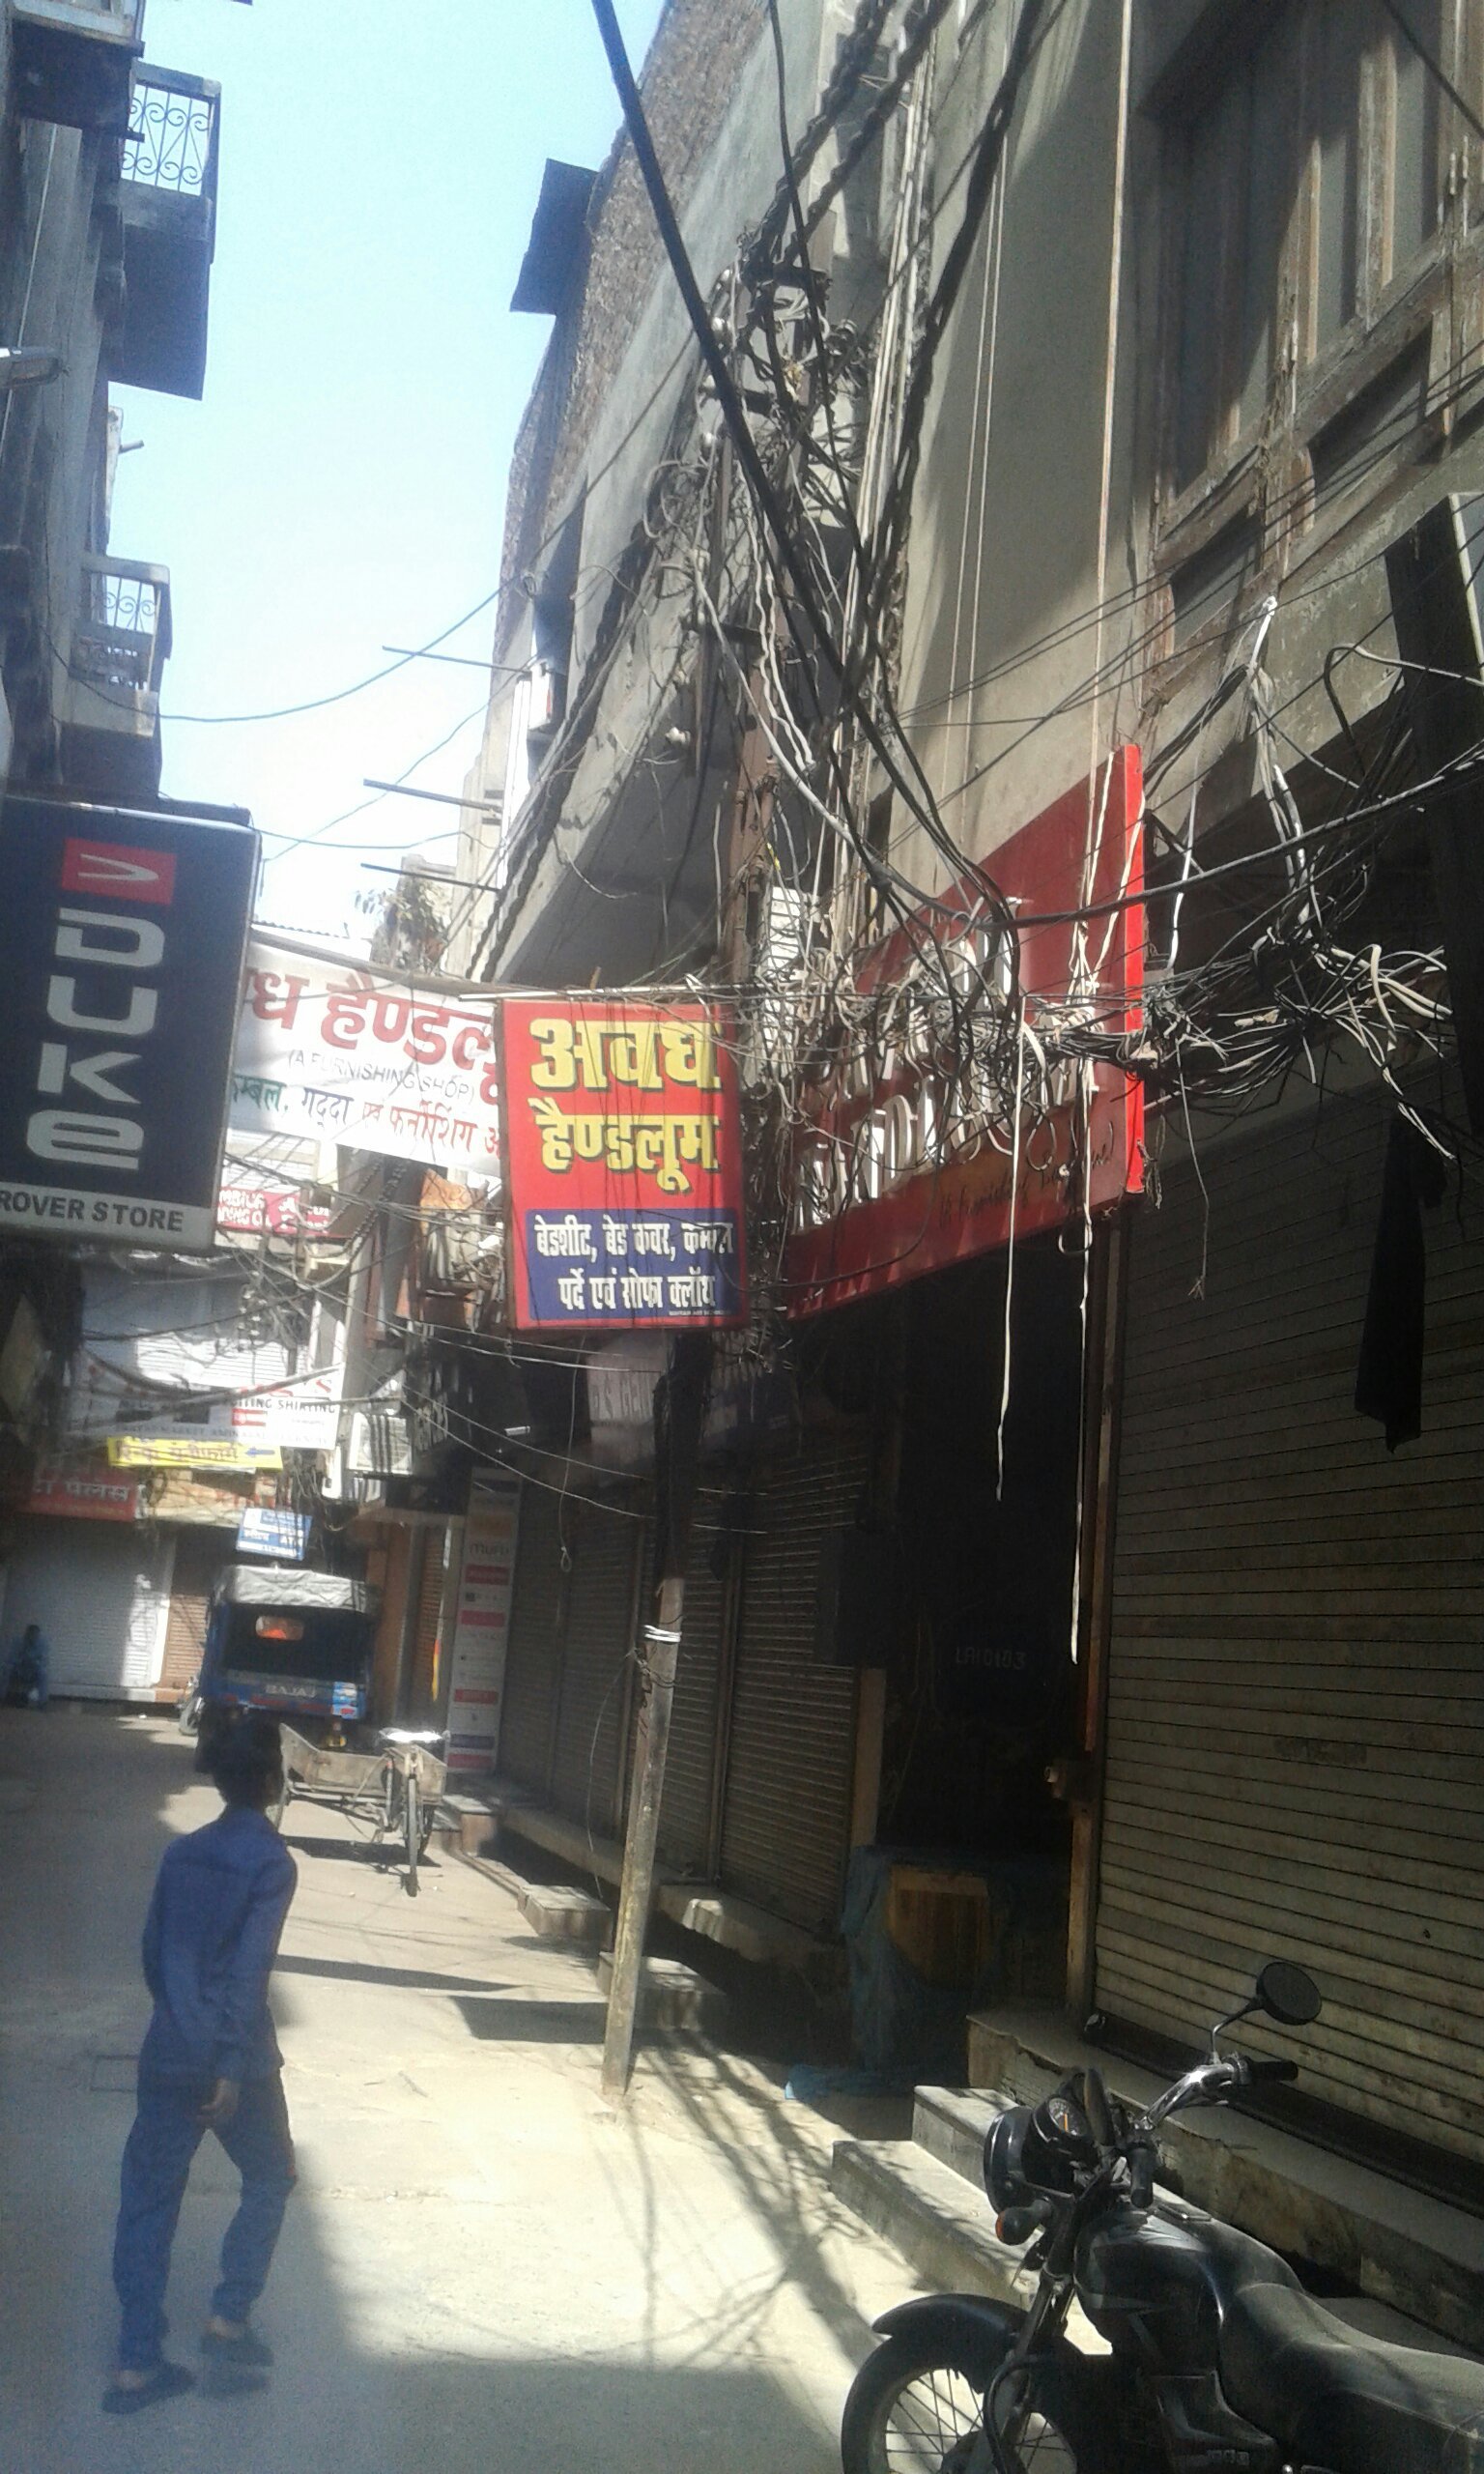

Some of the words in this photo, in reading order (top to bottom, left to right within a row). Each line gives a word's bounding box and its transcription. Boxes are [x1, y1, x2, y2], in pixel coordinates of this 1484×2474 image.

[91, 1201, 185, 1232] STORE
[602, 1214, 628, 1255] बेड
[588, 1267, 617, 1309] एवं
[620, 1267, 663, 1309] सोफा
